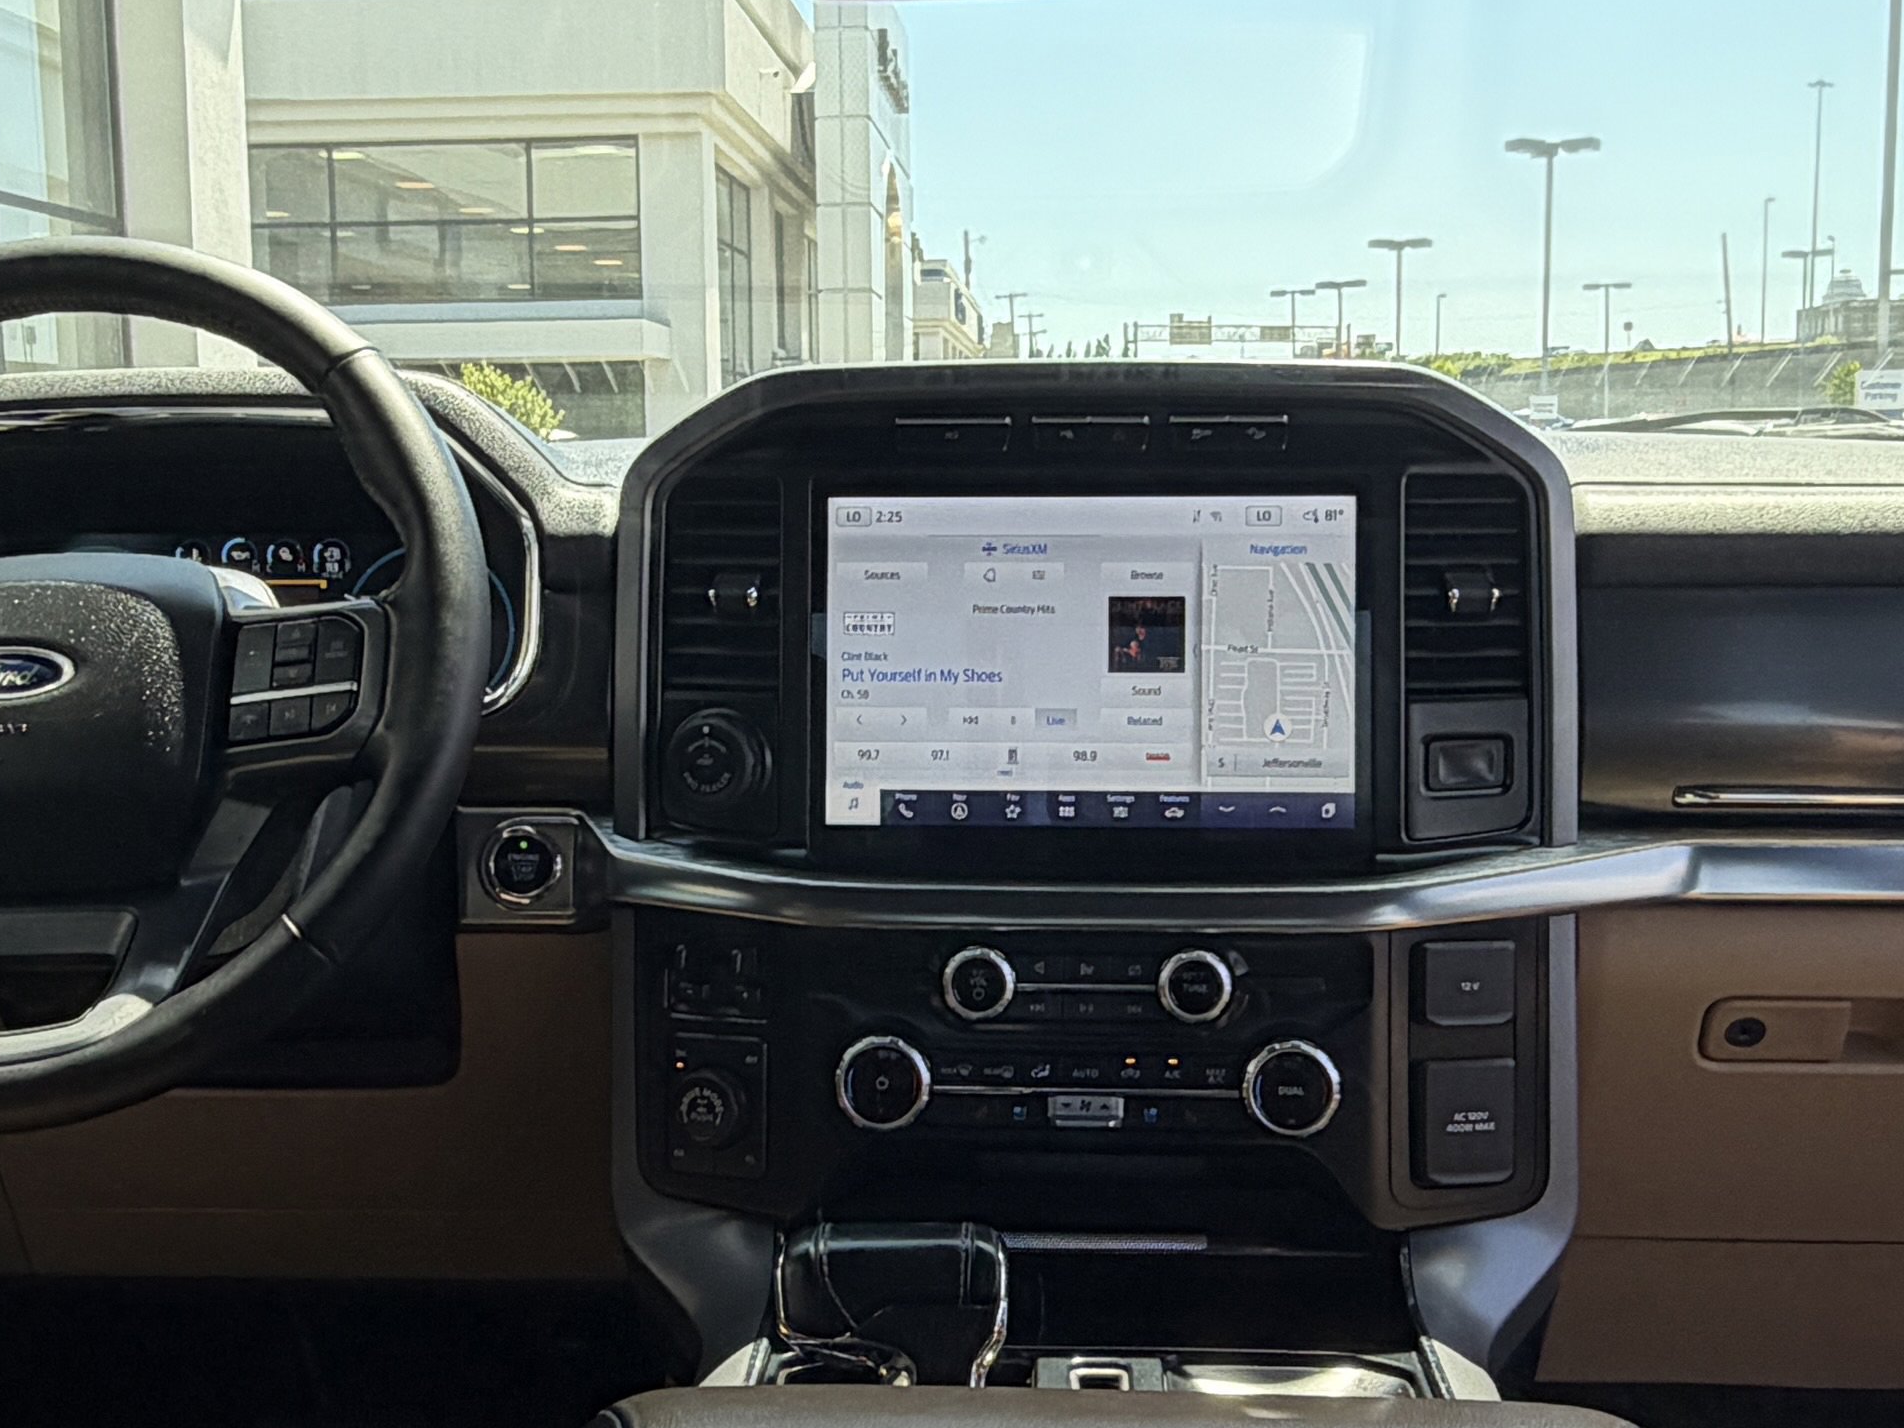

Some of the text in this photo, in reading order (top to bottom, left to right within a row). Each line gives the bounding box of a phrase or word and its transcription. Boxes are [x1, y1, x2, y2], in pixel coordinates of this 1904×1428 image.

[845, 510, 903, 523] LO 2:25
[1256, 509, 1272, 522] LO
[1249, 544, 1308, 556] Navigation
[972, 604, 998, 615] Prime
[1000, 604, 1035, 616] Country
[842, 668, 1003, 685] Put Yourself in My Shoes
[1131, 685, 1162, 697] Sound
[1072, 750, 1098, 762] 98.9
